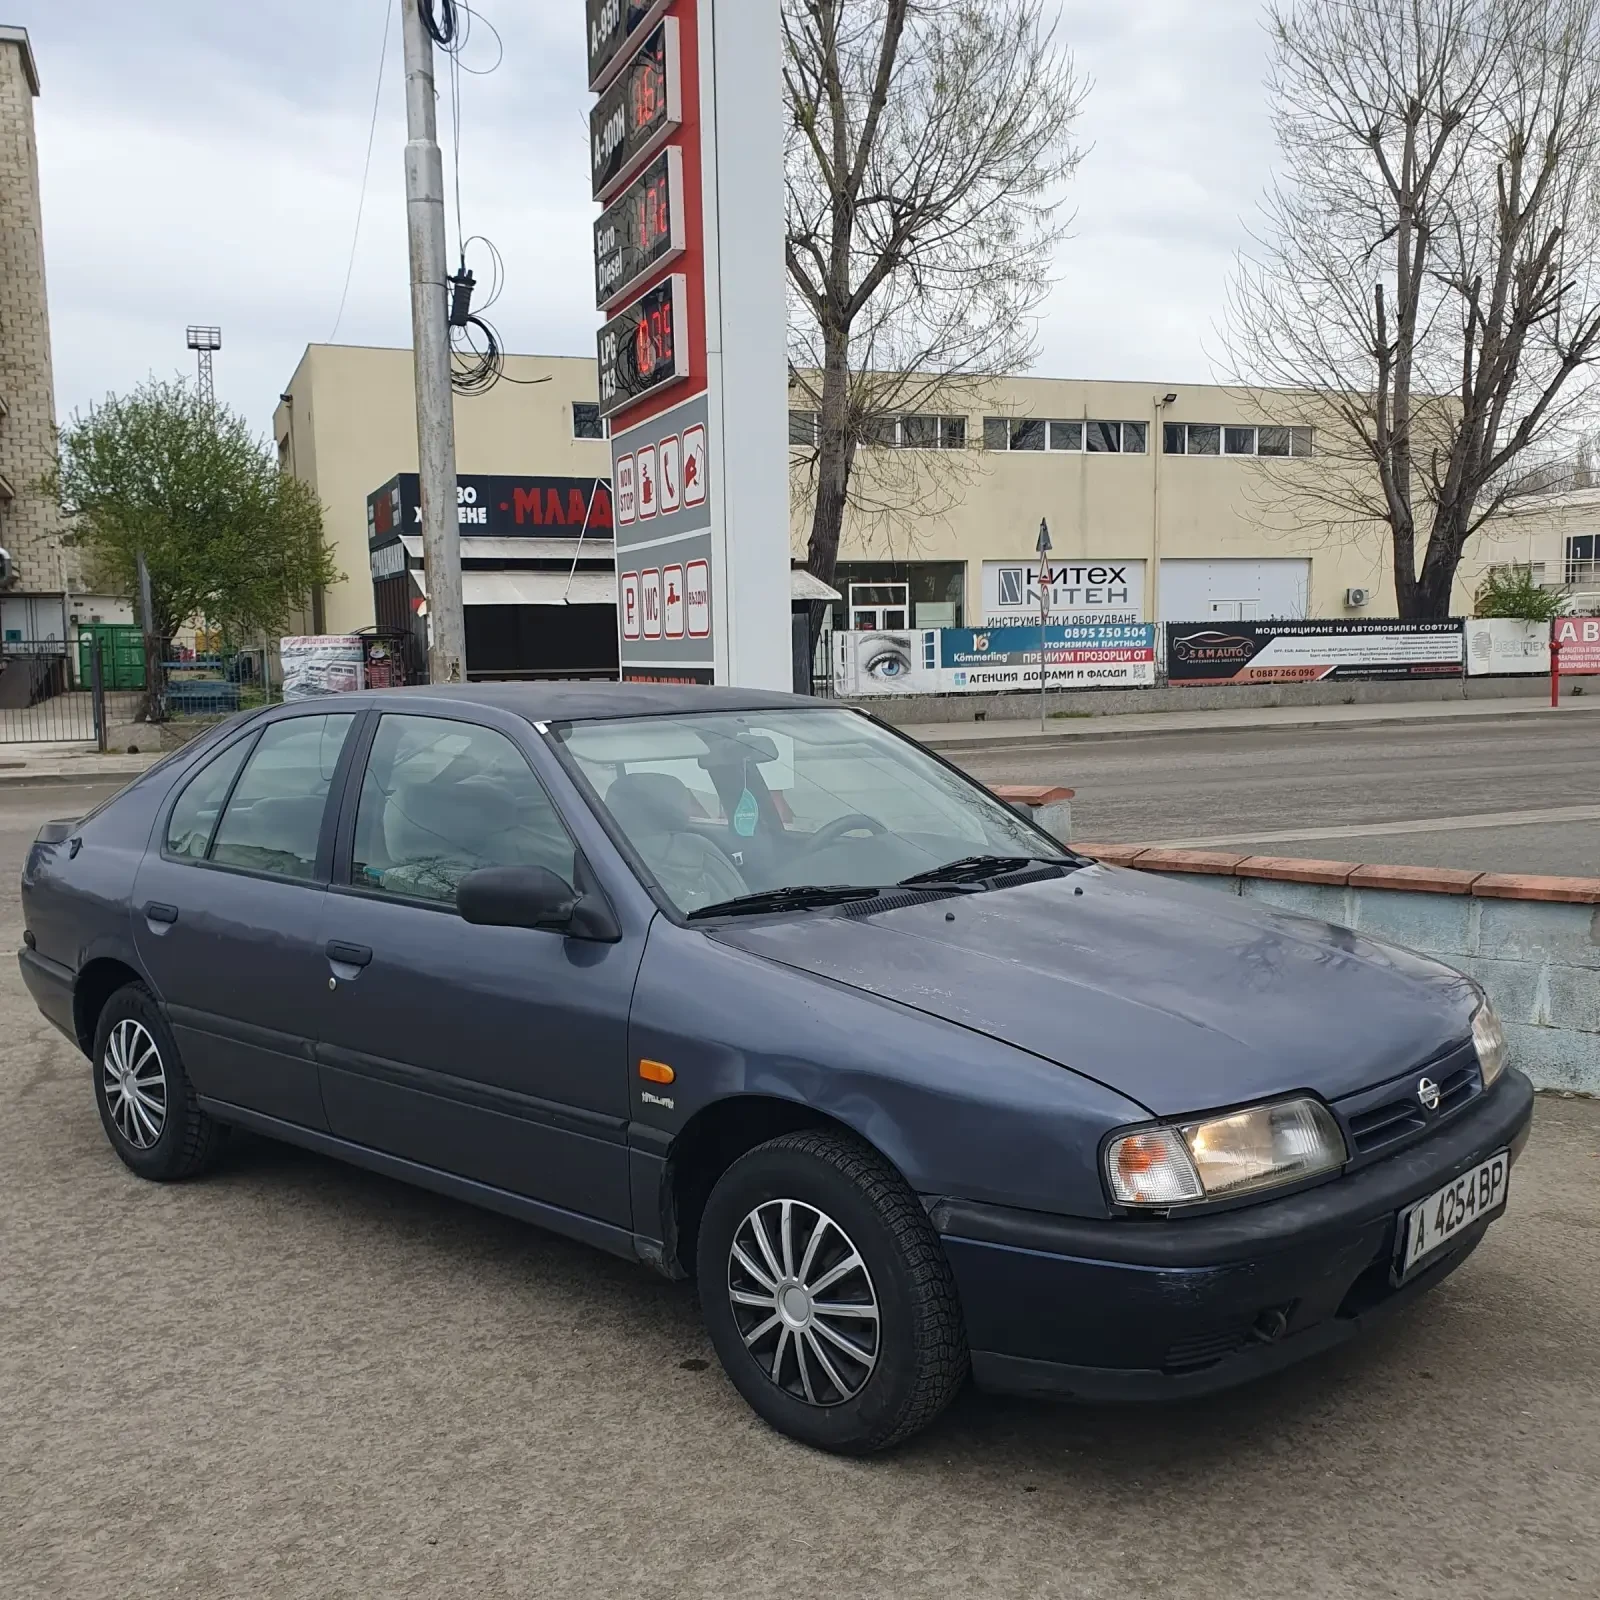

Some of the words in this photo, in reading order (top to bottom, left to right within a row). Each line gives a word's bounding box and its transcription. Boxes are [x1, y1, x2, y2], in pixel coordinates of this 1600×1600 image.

[598, 225, 615, 257] Euro
[599, 246, 623, 291] Diesel
[601, 331, 616, 366] LPG
[602, 368, 616, 400] ГАЗ
[620, 467, 632, 488] NON
[620, 492, 633, 512] STOP
[644, 587, 658, 620] WC
[1062, 615, 1069, 625] И
[1072, 614, 1137, 625] ОБОРУДВАНЕ
[1064, 627, 1096, 639] 0895
[1098, 627, 1121, 638] 250
[1123, 626, 1147, 637] 504
[1255, 626, 1333, 635] МОДИФИЦИРАНЕ
[1336, 625, 1349, 633] НА
[1351, 624, 1416, 633] АВТОМОБИЛЕН
[1419, 623, 1459, 631] СОФТУЕР
[1101, 640, 1147, 648] ПАРТНЬОР
[1077, 650, 1132, 662] ПРОЗОРЦИ
[1133, 650, 1147, 659] ОТ
[1190, 650, 1196, 658] S
[1206, 649, 1215, 657] M
[1216, 648, 1244, 658] AUTO
[969, 672, 1018, 683] АГЕНЦИЯ
[1077, 670, 1084, 679] И
[1087, 669, 1127, 679] ФАСАДИ
[1256, 670, 1278, 678] 0887
[1281, 669, 1297, 677] 266
[1299, 669, 1315, 677] 096
[1414, 1208, 1425, 1256] A
[1434, 1174, 1476, 1237] 4254
[1479, 1160, 1503, 1211] BP
